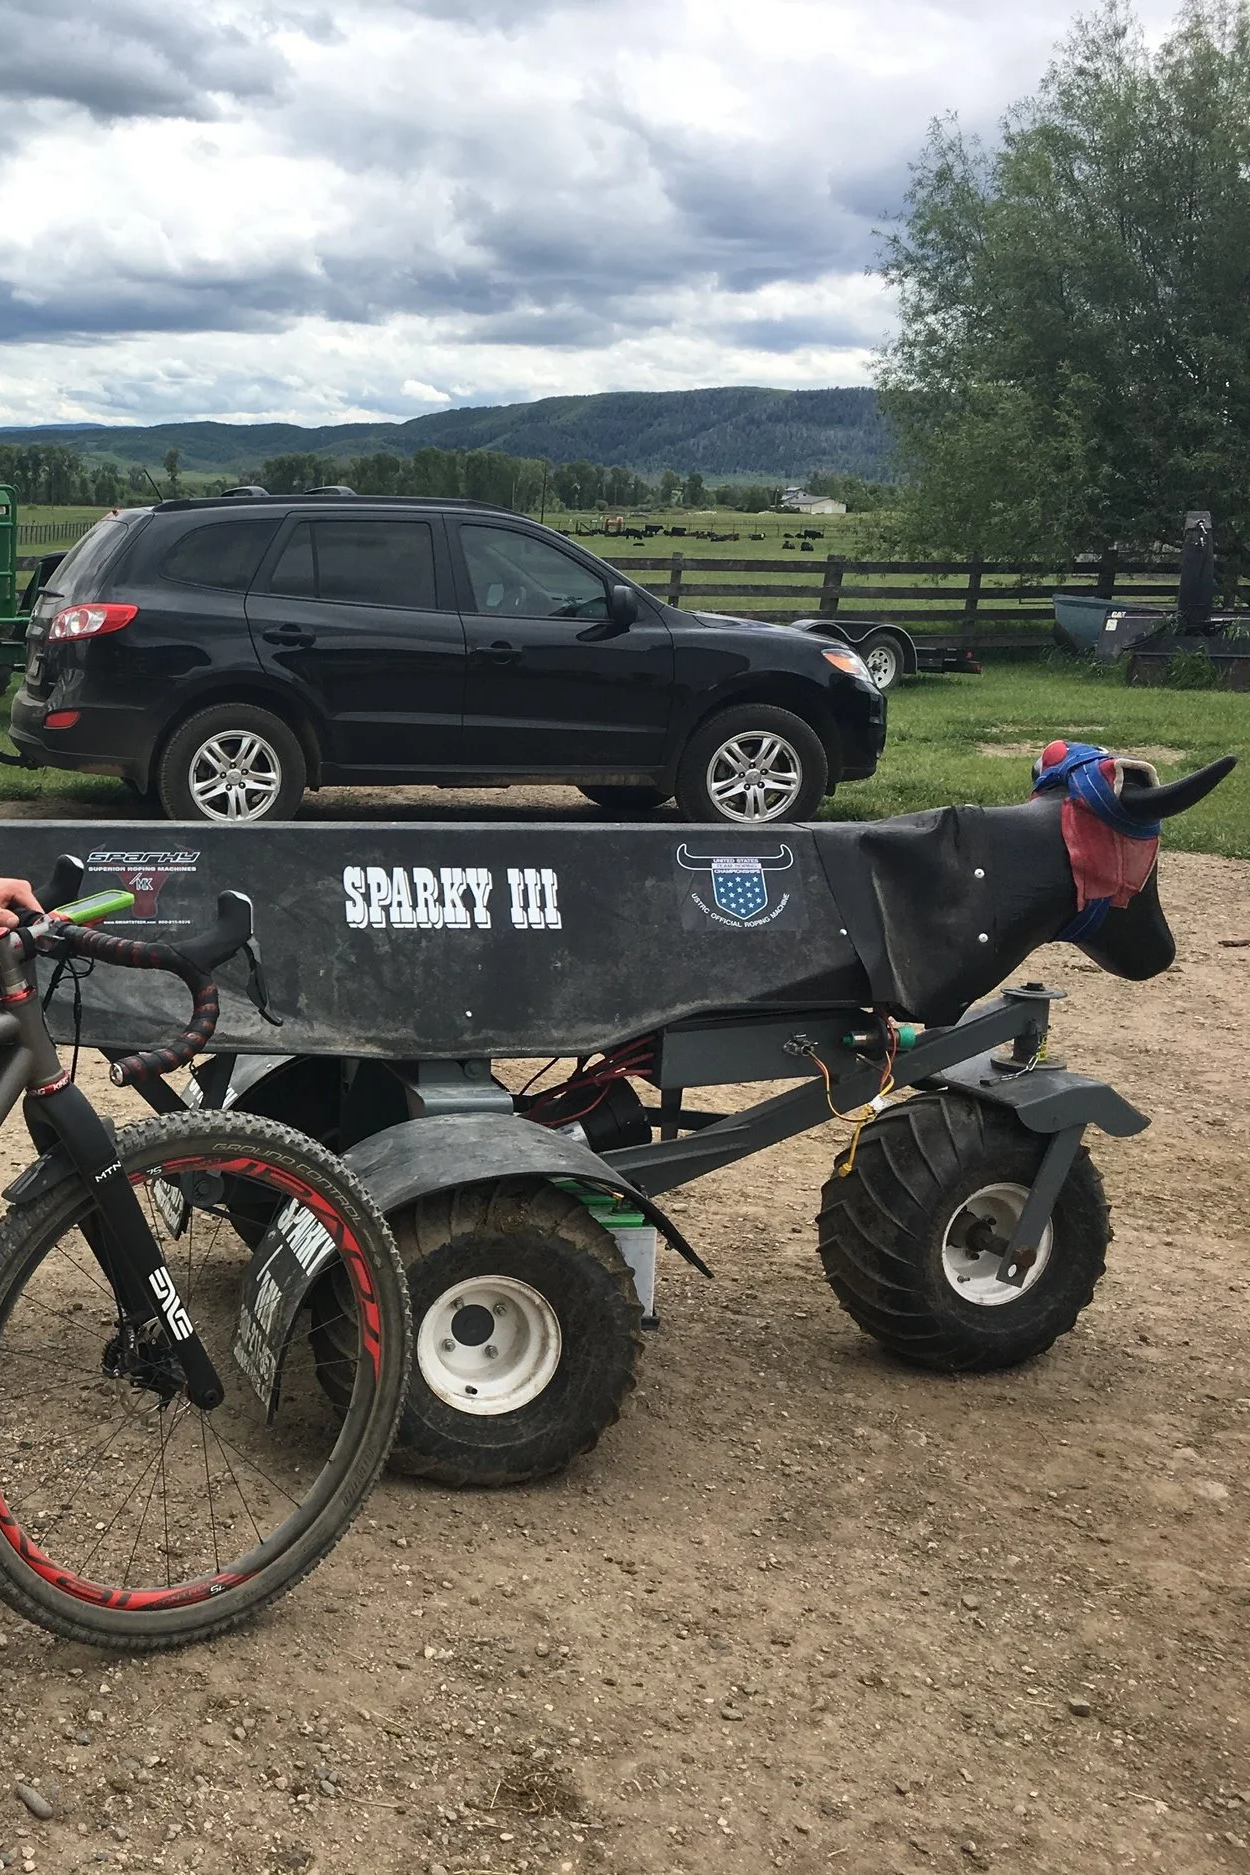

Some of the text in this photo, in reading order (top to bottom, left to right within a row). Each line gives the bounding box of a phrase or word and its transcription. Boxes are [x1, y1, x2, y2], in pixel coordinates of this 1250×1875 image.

[343, 865, 563, 930] SPARKY III
[690, 893, 790, 928] USTRC OFFICIAL ROPING MACHINE
[95, 1160, 122, 1183] MTN
[212, 1143, 363, 1227] GROUND CONTROL
[209, 1584, 226, 1596] SL
